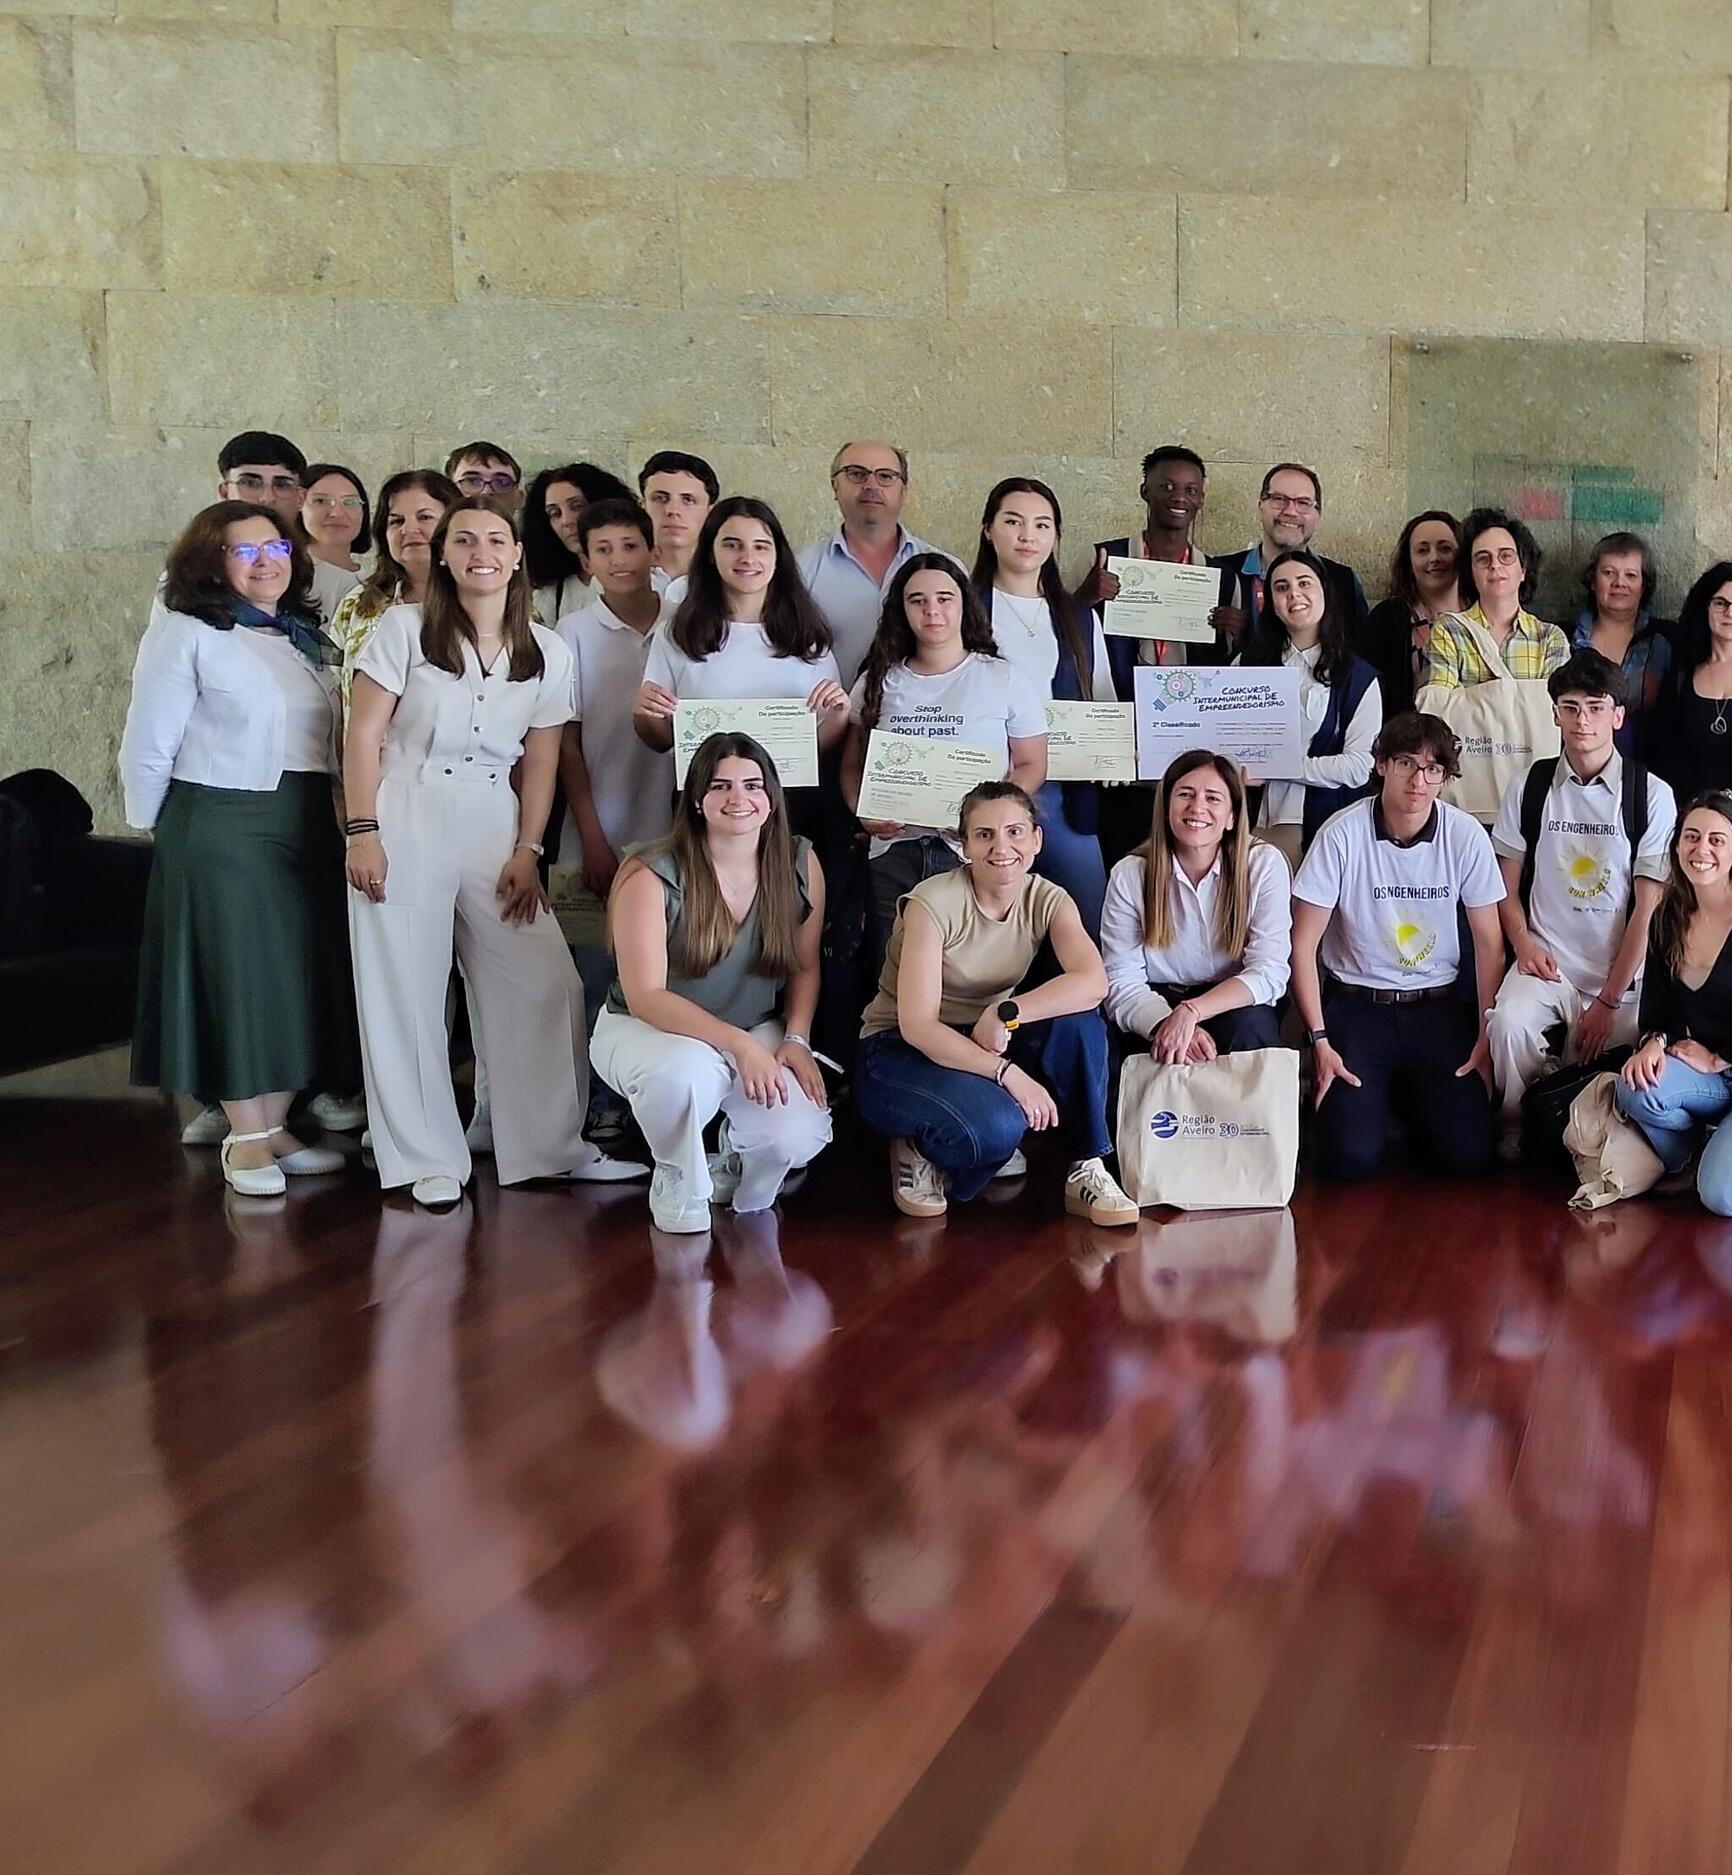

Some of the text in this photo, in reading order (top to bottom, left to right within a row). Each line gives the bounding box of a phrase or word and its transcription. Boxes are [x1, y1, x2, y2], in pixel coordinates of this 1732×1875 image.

[1221, 685, 1271, 696] CONCURSO
[1193, 692, 1278, 704] INTERMUNICIPAL DE
[914, 705, 942, 713] Stop
[1199, 700, 1285, 712] EMPREENDEDORISMO
[890, 714, 964, 724] overthinking
[891, 727, 960, 737] about past.
[1465, 736, 1492, 746] Região
[1466, 745, 1493, 754] Aveiro
[1548, 820, 1561, 832] OS
[1182, 1114, 1215, 1126] Região
[1183, 1124, 1216, 1135] Aveiro
[1219, 1123, 1239, 1137] 30
